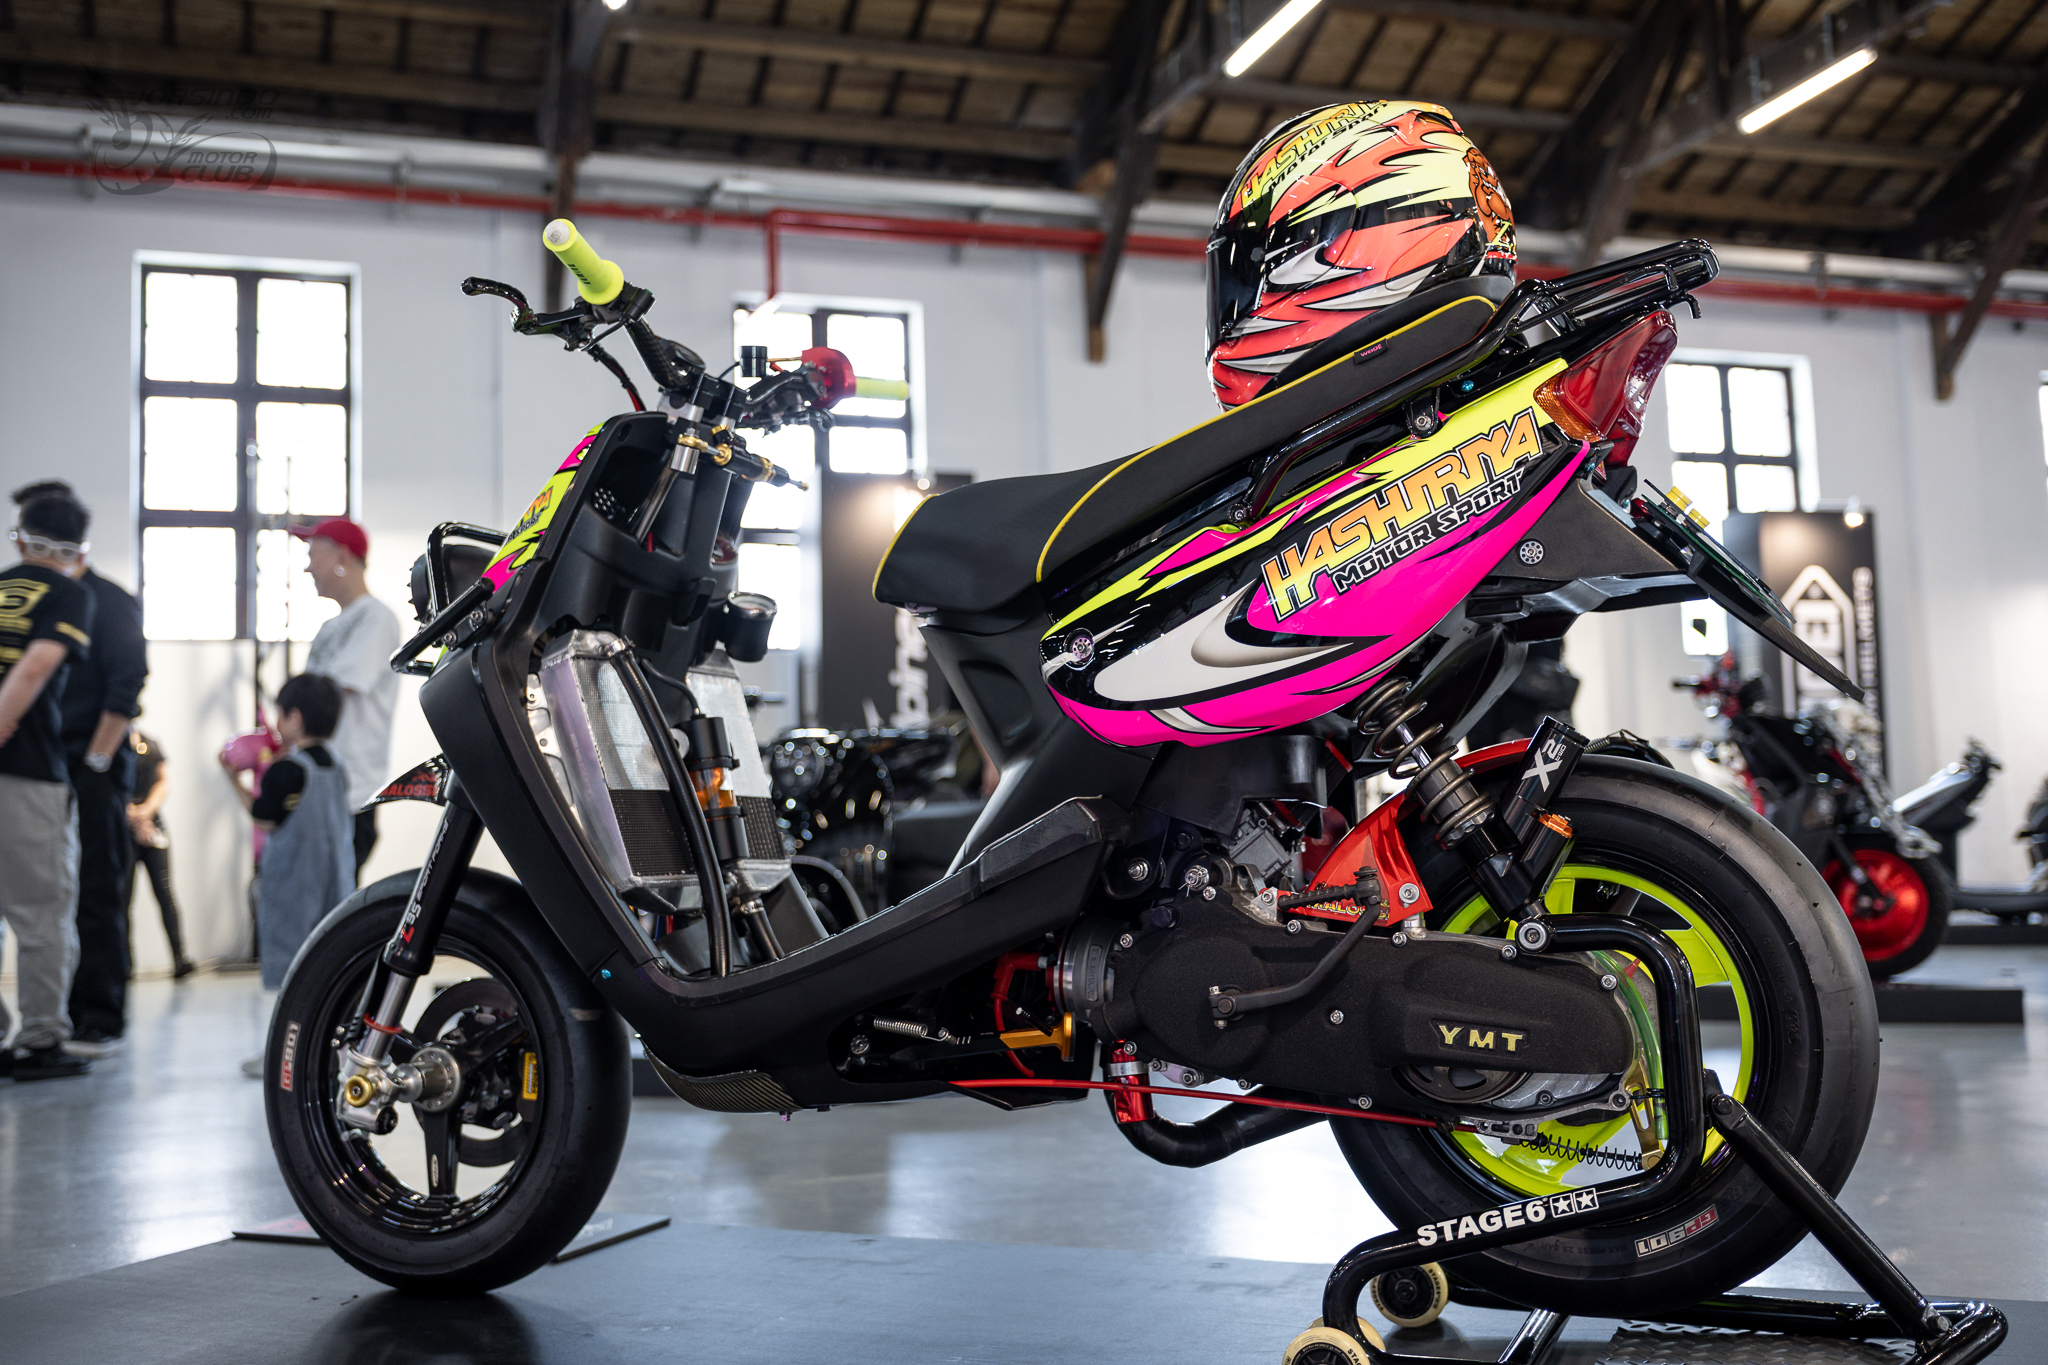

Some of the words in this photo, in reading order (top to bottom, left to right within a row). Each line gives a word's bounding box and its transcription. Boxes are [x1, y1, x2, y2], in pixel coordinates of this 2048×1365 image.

[1330, 521, 1437, 597] MOTOR
[1436, 466, 1528, 535] SPORT
[1438, 1024, 1523, 1052] YMT
[1416, 1200, 1547, 1248] STAGE6
[1636, 1206, 1719, 1257] GP901
